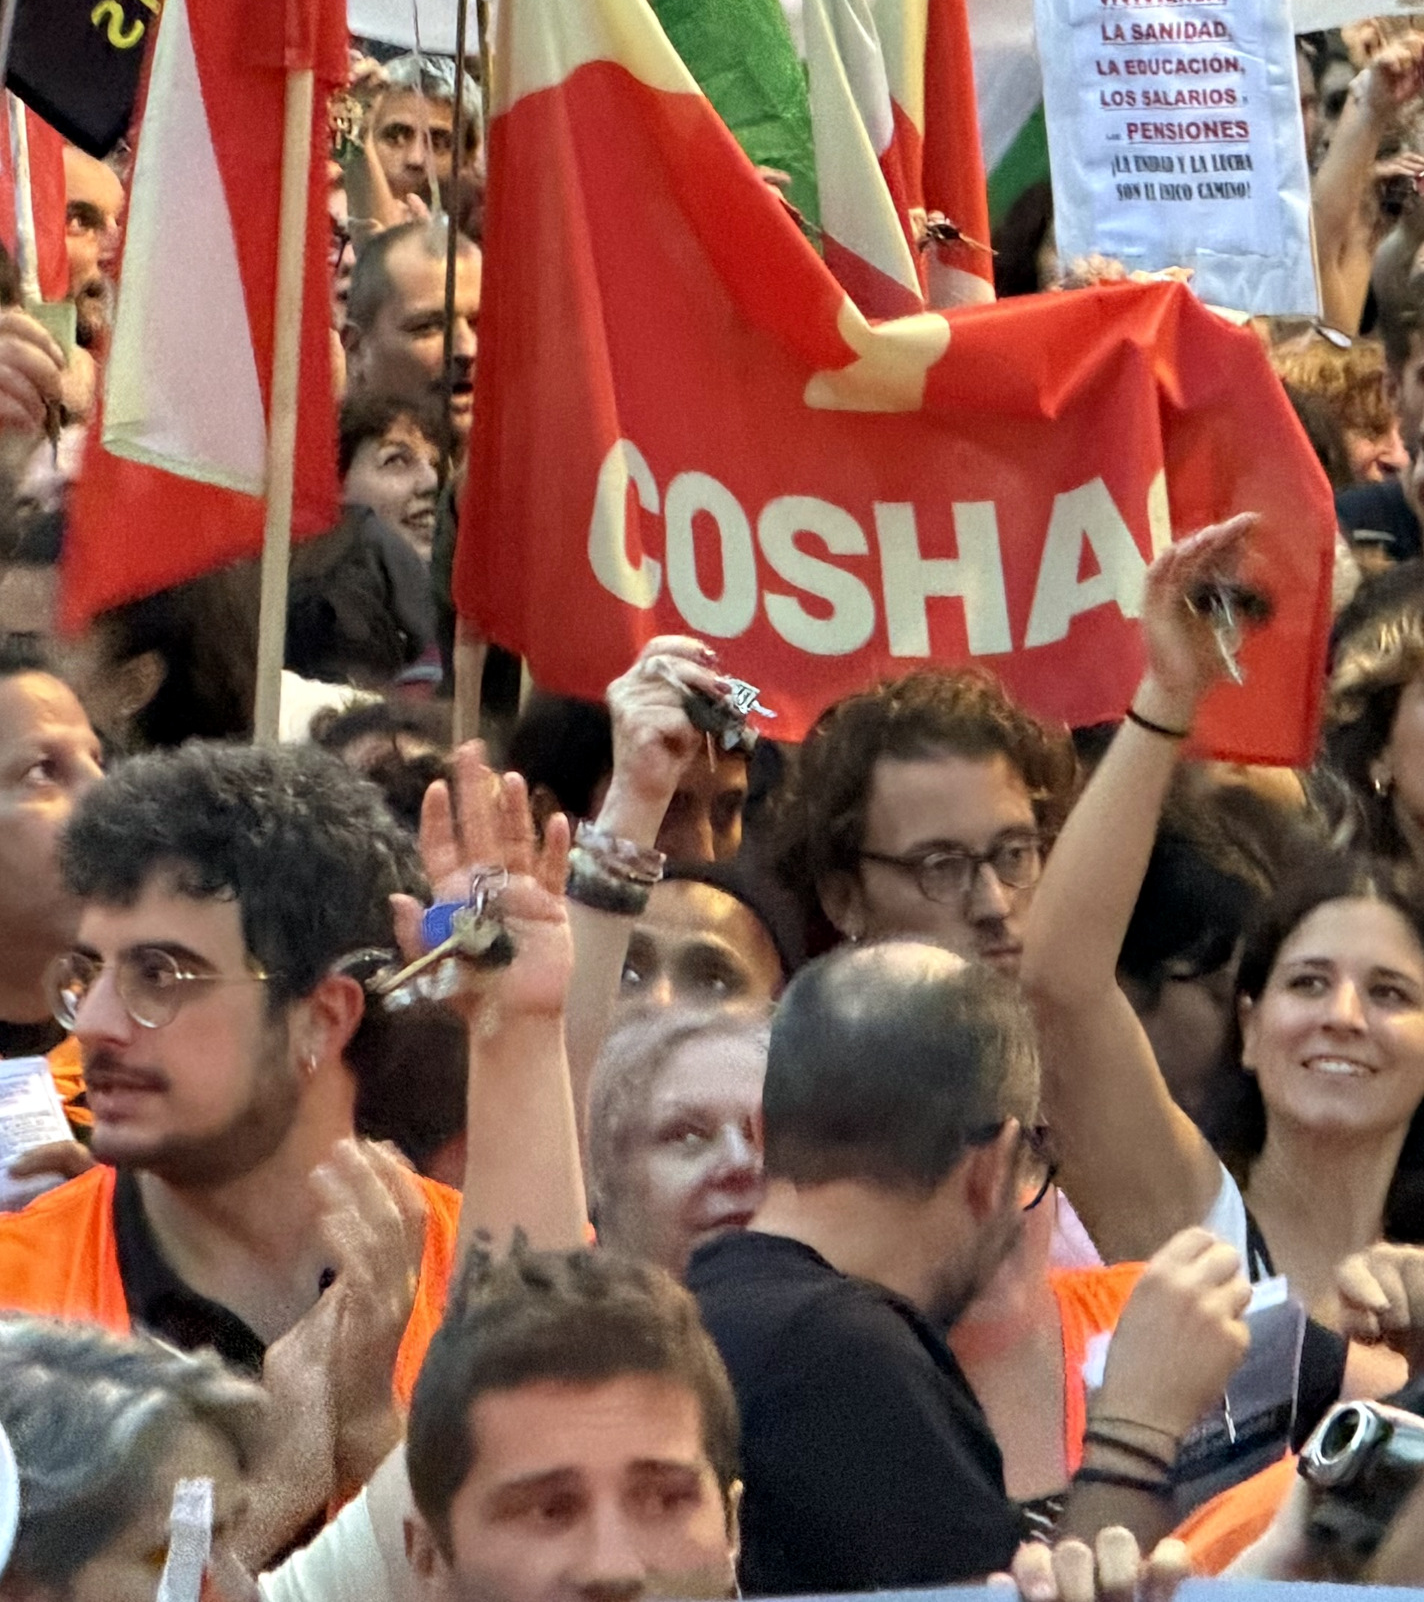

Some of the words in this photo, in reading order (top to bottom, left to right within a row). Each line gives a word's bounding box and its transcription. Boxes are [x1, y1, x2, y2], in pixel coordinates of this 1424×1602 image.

[1101, 23, 1125, 42] LA
[1096, 60, 1121, 76] LA
[1099, 89, 1136, 107] LOS
[1126, 119, 1250, 141] PENSIONES
[1190, 154, 1208, 174] LA
[587, 438, 1172, 657] COSHA
